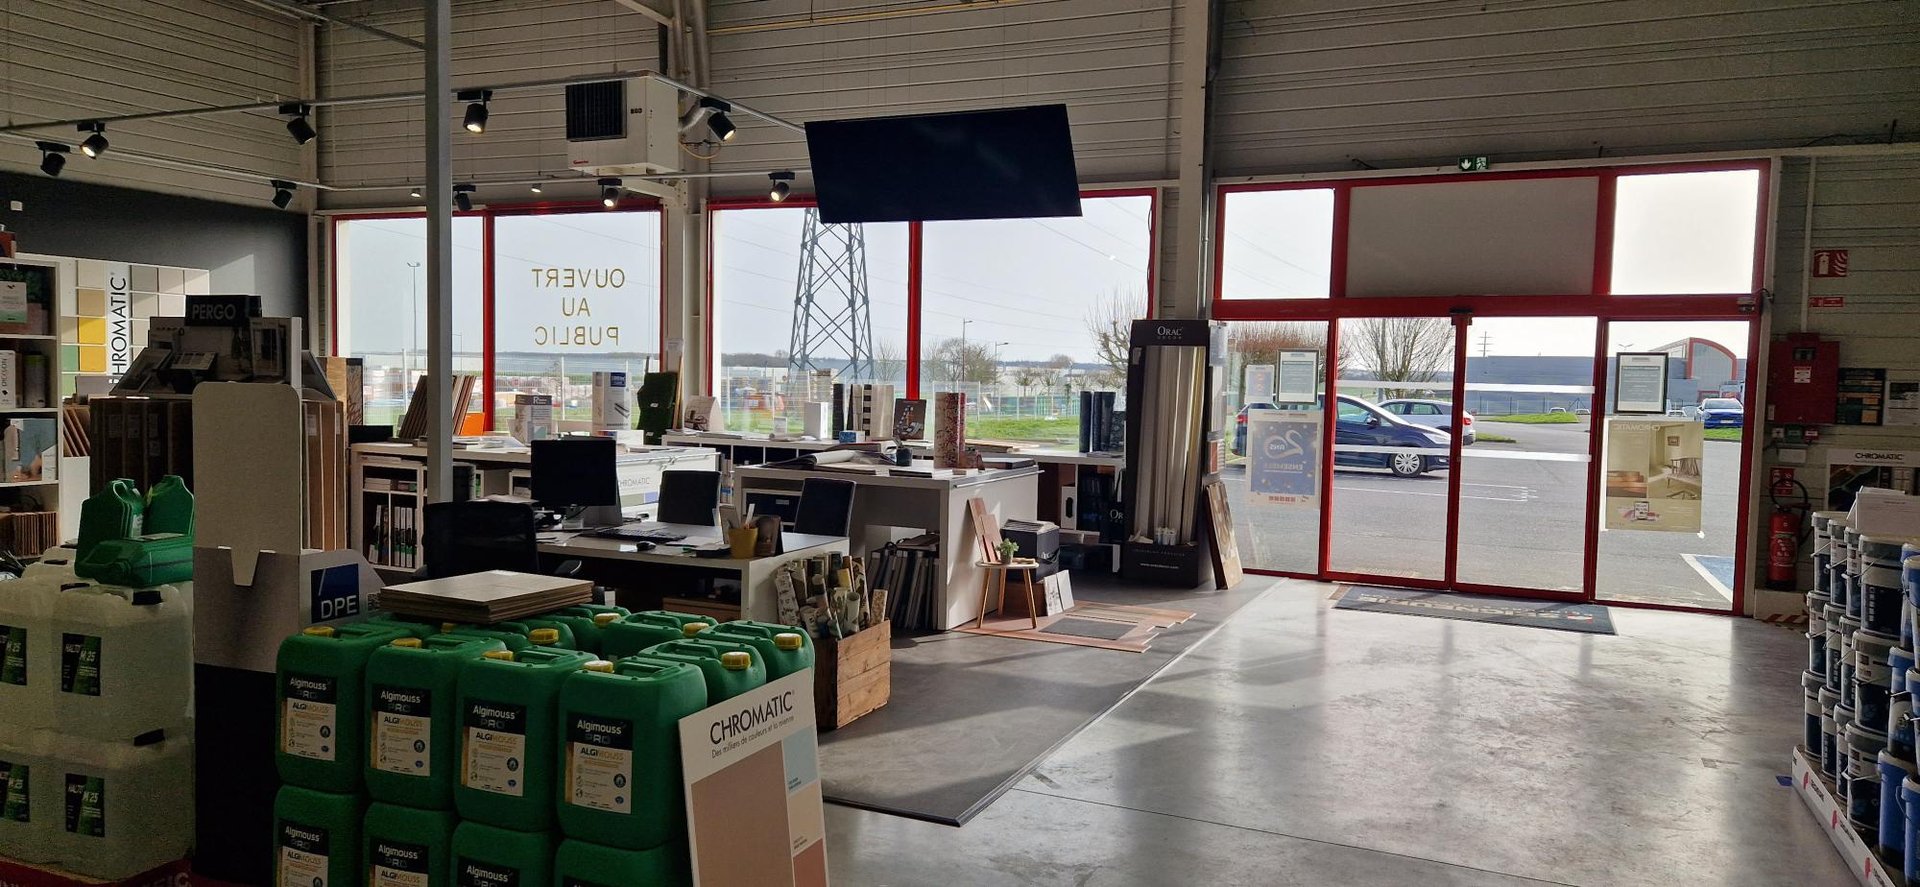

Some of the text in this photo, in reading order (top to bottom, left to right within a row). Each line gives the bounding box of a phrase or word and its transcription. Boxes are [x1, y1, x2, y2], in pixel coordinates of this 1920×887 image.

[191, 303, 237, 321] PERGO
[111, 276, 127, 384] HROMATIC
[320, 594, 358, 620] DPE
[290, 677, 328, 692] Algimouss
[380, 690, 423, 705] Algimouss
[472, 704, 517, 721] Algimouss
[709, 691, 793, 745] CHROMATIC
[576, 718, 624, 737] Algimouss
[284, 826, 321, 844] Algimouss
[378, 844, 419, 861] Algimouss
[466, 865, 510, 884] Algimouss
